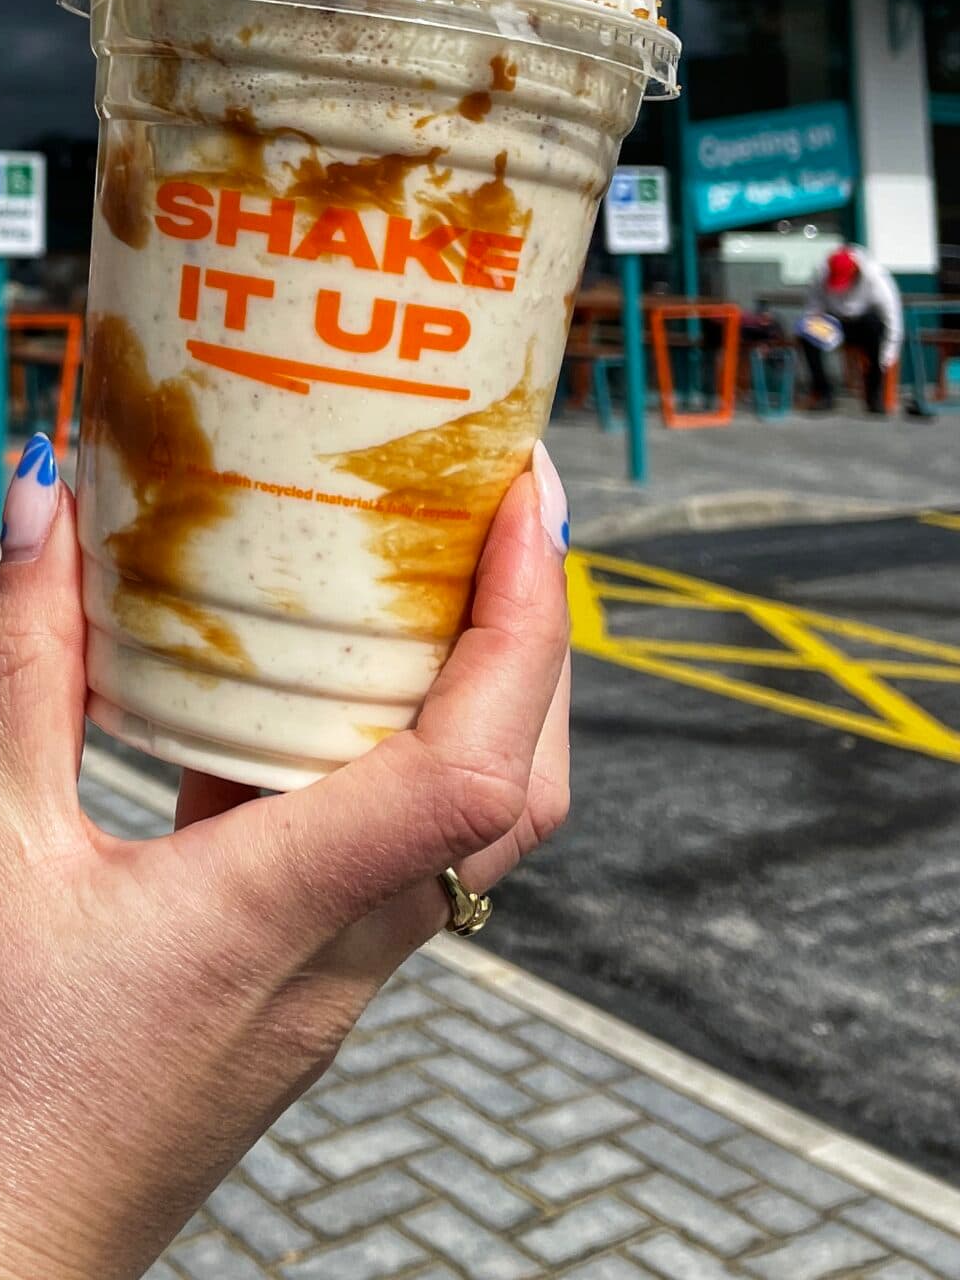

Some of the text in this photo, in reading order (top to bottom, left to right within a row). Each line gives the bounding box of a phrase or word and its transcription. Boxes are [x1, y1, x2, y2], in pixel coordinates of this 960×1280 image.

[154, 181, 524, 292] SHAKE
[178, 264, 472, 361] IT UP
[254, 480, 314, 501] recycled
[316, 491, 373, 511] material
